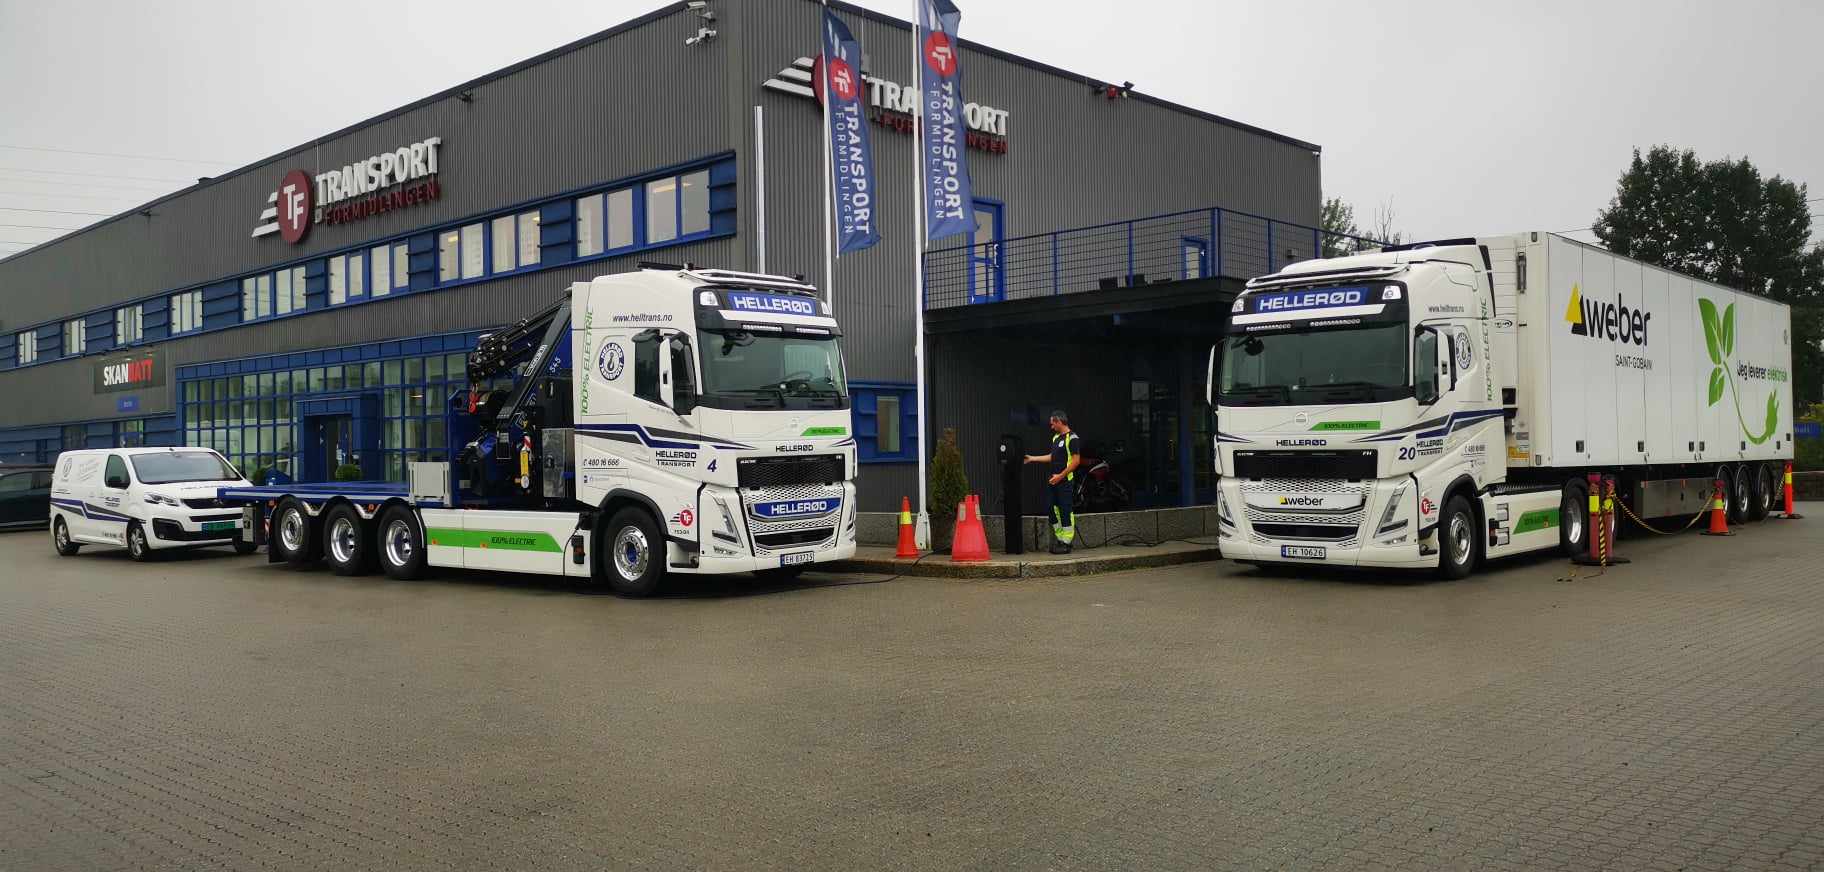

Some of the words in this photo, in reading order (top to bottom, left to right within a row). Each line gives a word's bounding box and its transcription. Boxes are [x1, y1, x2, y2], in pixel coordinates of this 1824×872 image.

[865, 77, 1009, 136] TRAORT
[930, 90, 944, 219] FORMIDLINGEN
[942, 81, 963, 219] TRANSPORT
[315, 136, 441, 206] TRANSPORT
[835, 112, 853, 233] FORMIDLINGEN
[844, 103, 870, 234] TRANSPORT
[283, 184, 304, 230] TF
[733, 296, 813, 314] HELLERØD
[1259, 291, 1361, 311] HELLERØD
[613, 313, 673, 322] www.helltrans.no
[1586, 292, 1651, 347] weber
[1616, 355, 1653, 369] SAINT-GOBAIN
[775, 444, 814, 453] HELLERØD
[1276, 439, 1328, 448] HELLERØD
[656, 450, 697, 459] HELLERØD
[1398, 447, 1416, 461] 20
[656, 459, 697, 468] TRANSPORT
[707, 459, 718, 473] 4
[771, 501, 827, 514] HELLERØD
[1287, 496, 1324, 506] weber
[1287, 547, 1298, 556] EH
[1301, 548, 1323, 557] 10626
